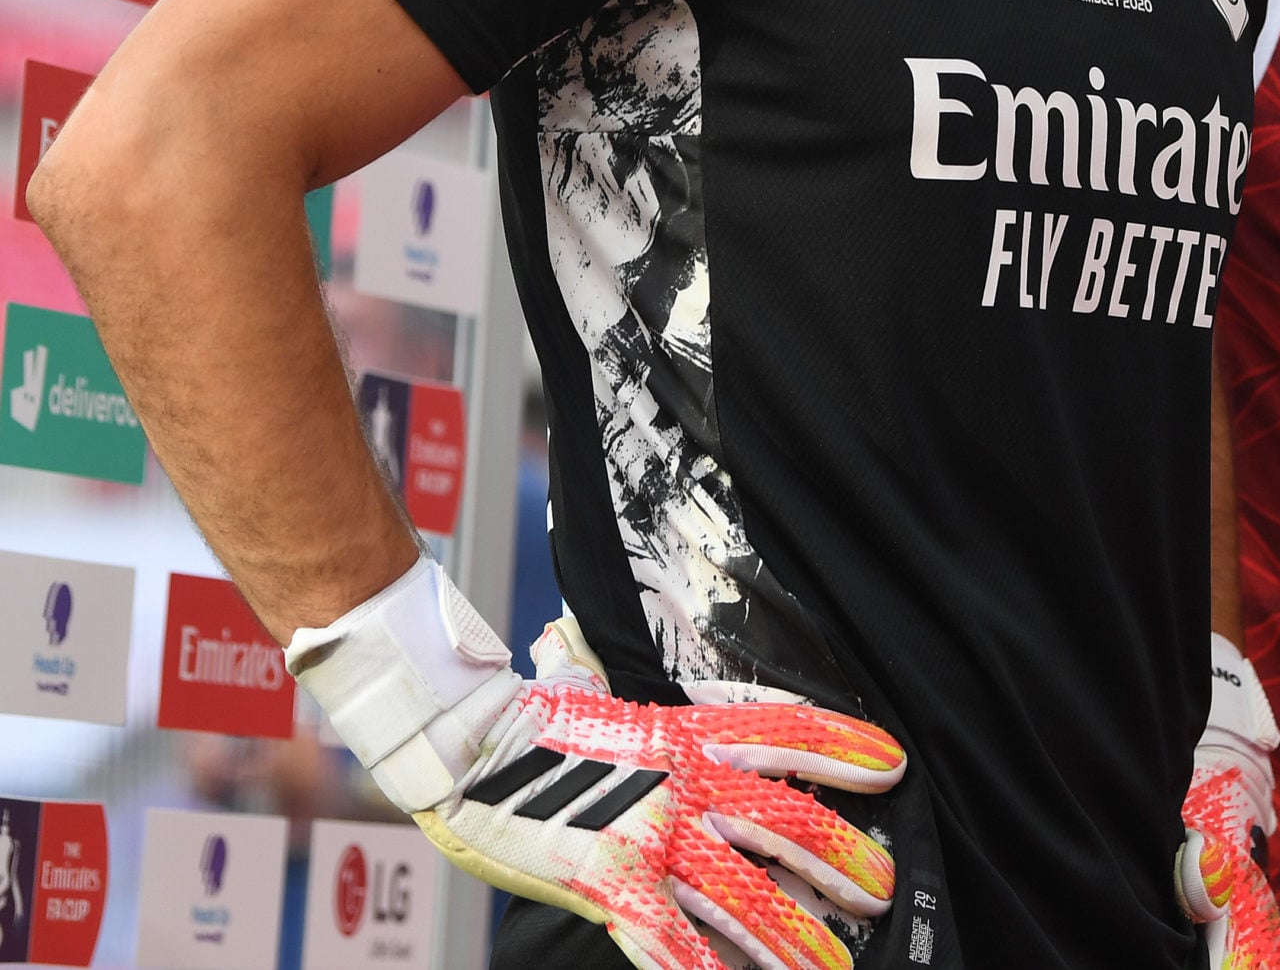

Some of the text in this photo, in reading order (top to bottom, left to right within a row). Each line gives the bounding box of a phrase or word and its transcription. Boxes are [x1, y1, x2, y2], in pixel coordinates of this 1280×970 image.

[903, 57, 1252, 216] Emirate
[981, 209, 1228, 329] FLY BETTE
[179, 625, 285, 691] Emirates
[41, 860, 100, 892] Emirates
[372, 861, 412, 924] LG
[909, 915, 921, 961] AUTHENTIC
[916, 923, 927, 964] LICENSED
[925, 928, 934, 965] PRODUCT
